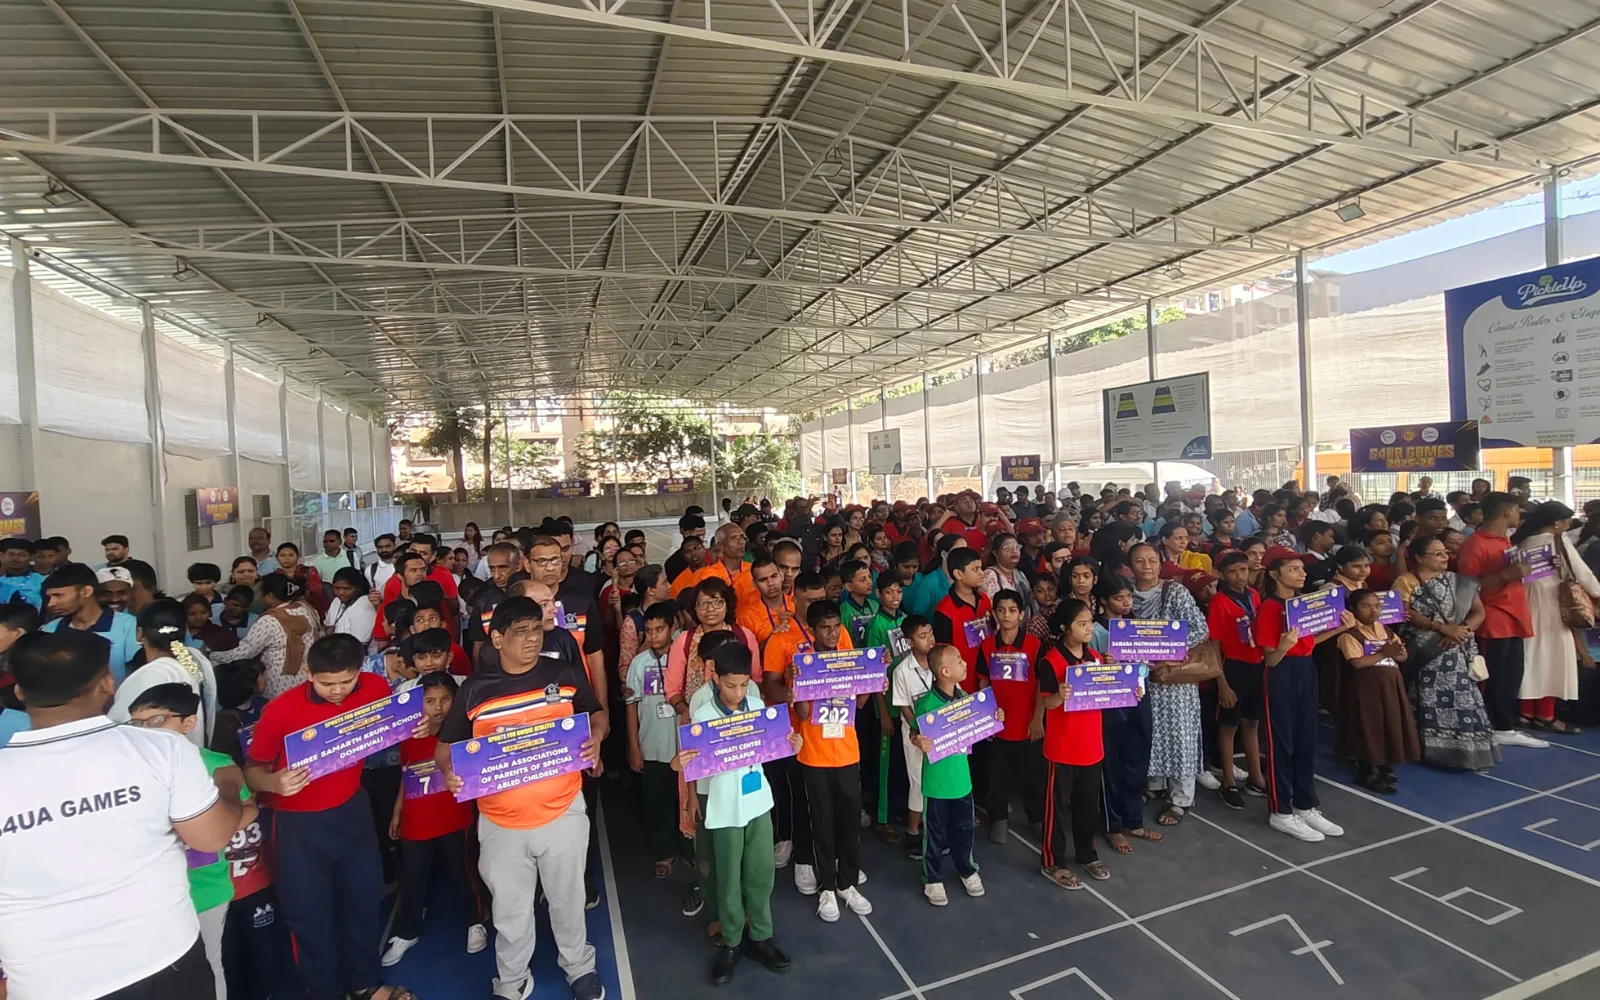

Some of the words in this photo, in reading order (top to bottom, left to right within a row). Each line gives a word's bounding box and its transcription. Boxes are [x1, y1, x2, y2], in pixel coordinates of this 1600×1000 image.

[1517, 275, 1585, 301] PickleUp
[1488, 321, 1517, 334] Court
[1519, 315, 1550, 328] Rules
[1405, 444, 1455, 459] GAMES
[895, 637, 911, 654] 18
[825, 675, 853, 683] EDUCATION
[854, 672, 885, 680] FOUNDATION
[1003, 665, 1012, 679] 2
[818, 706, 849, 724] 202
[291, 754, 318, 770] SHREE
[320, 736, 362, 758] SAMARTH
[363, 725, 390, 740] KRUPA
[391, 711, 422, 728] SCHOOL
[340, 736, 384, 759] DOMBIVALI
[714, 745, 738, 756] UNNATI
[738, 740, 761, 750] CENTRE
[481, 763, 509, 775] ADHAR
[511, 746, 569, 767] ASSOCIATIONS
[724, 750, 755, 763] BADLAPUR
[481, 776, 492, 784] OF
[494, 767, 528, 780] PARENTS
[530, 763, 541, 771] OF
[543, 755, 573, 768] SPECIAL
[497, 779, 520, 790] ABLED
[522, 768, 559, 782] CHILDREN
[419, 776, 430, 795] 7
[0, 806, 54, 837] 4UA
[60, 785, 141, 818] GAMES
[225, 822, 262, 852] 93
[1229, 913, 1345, 985] 7
